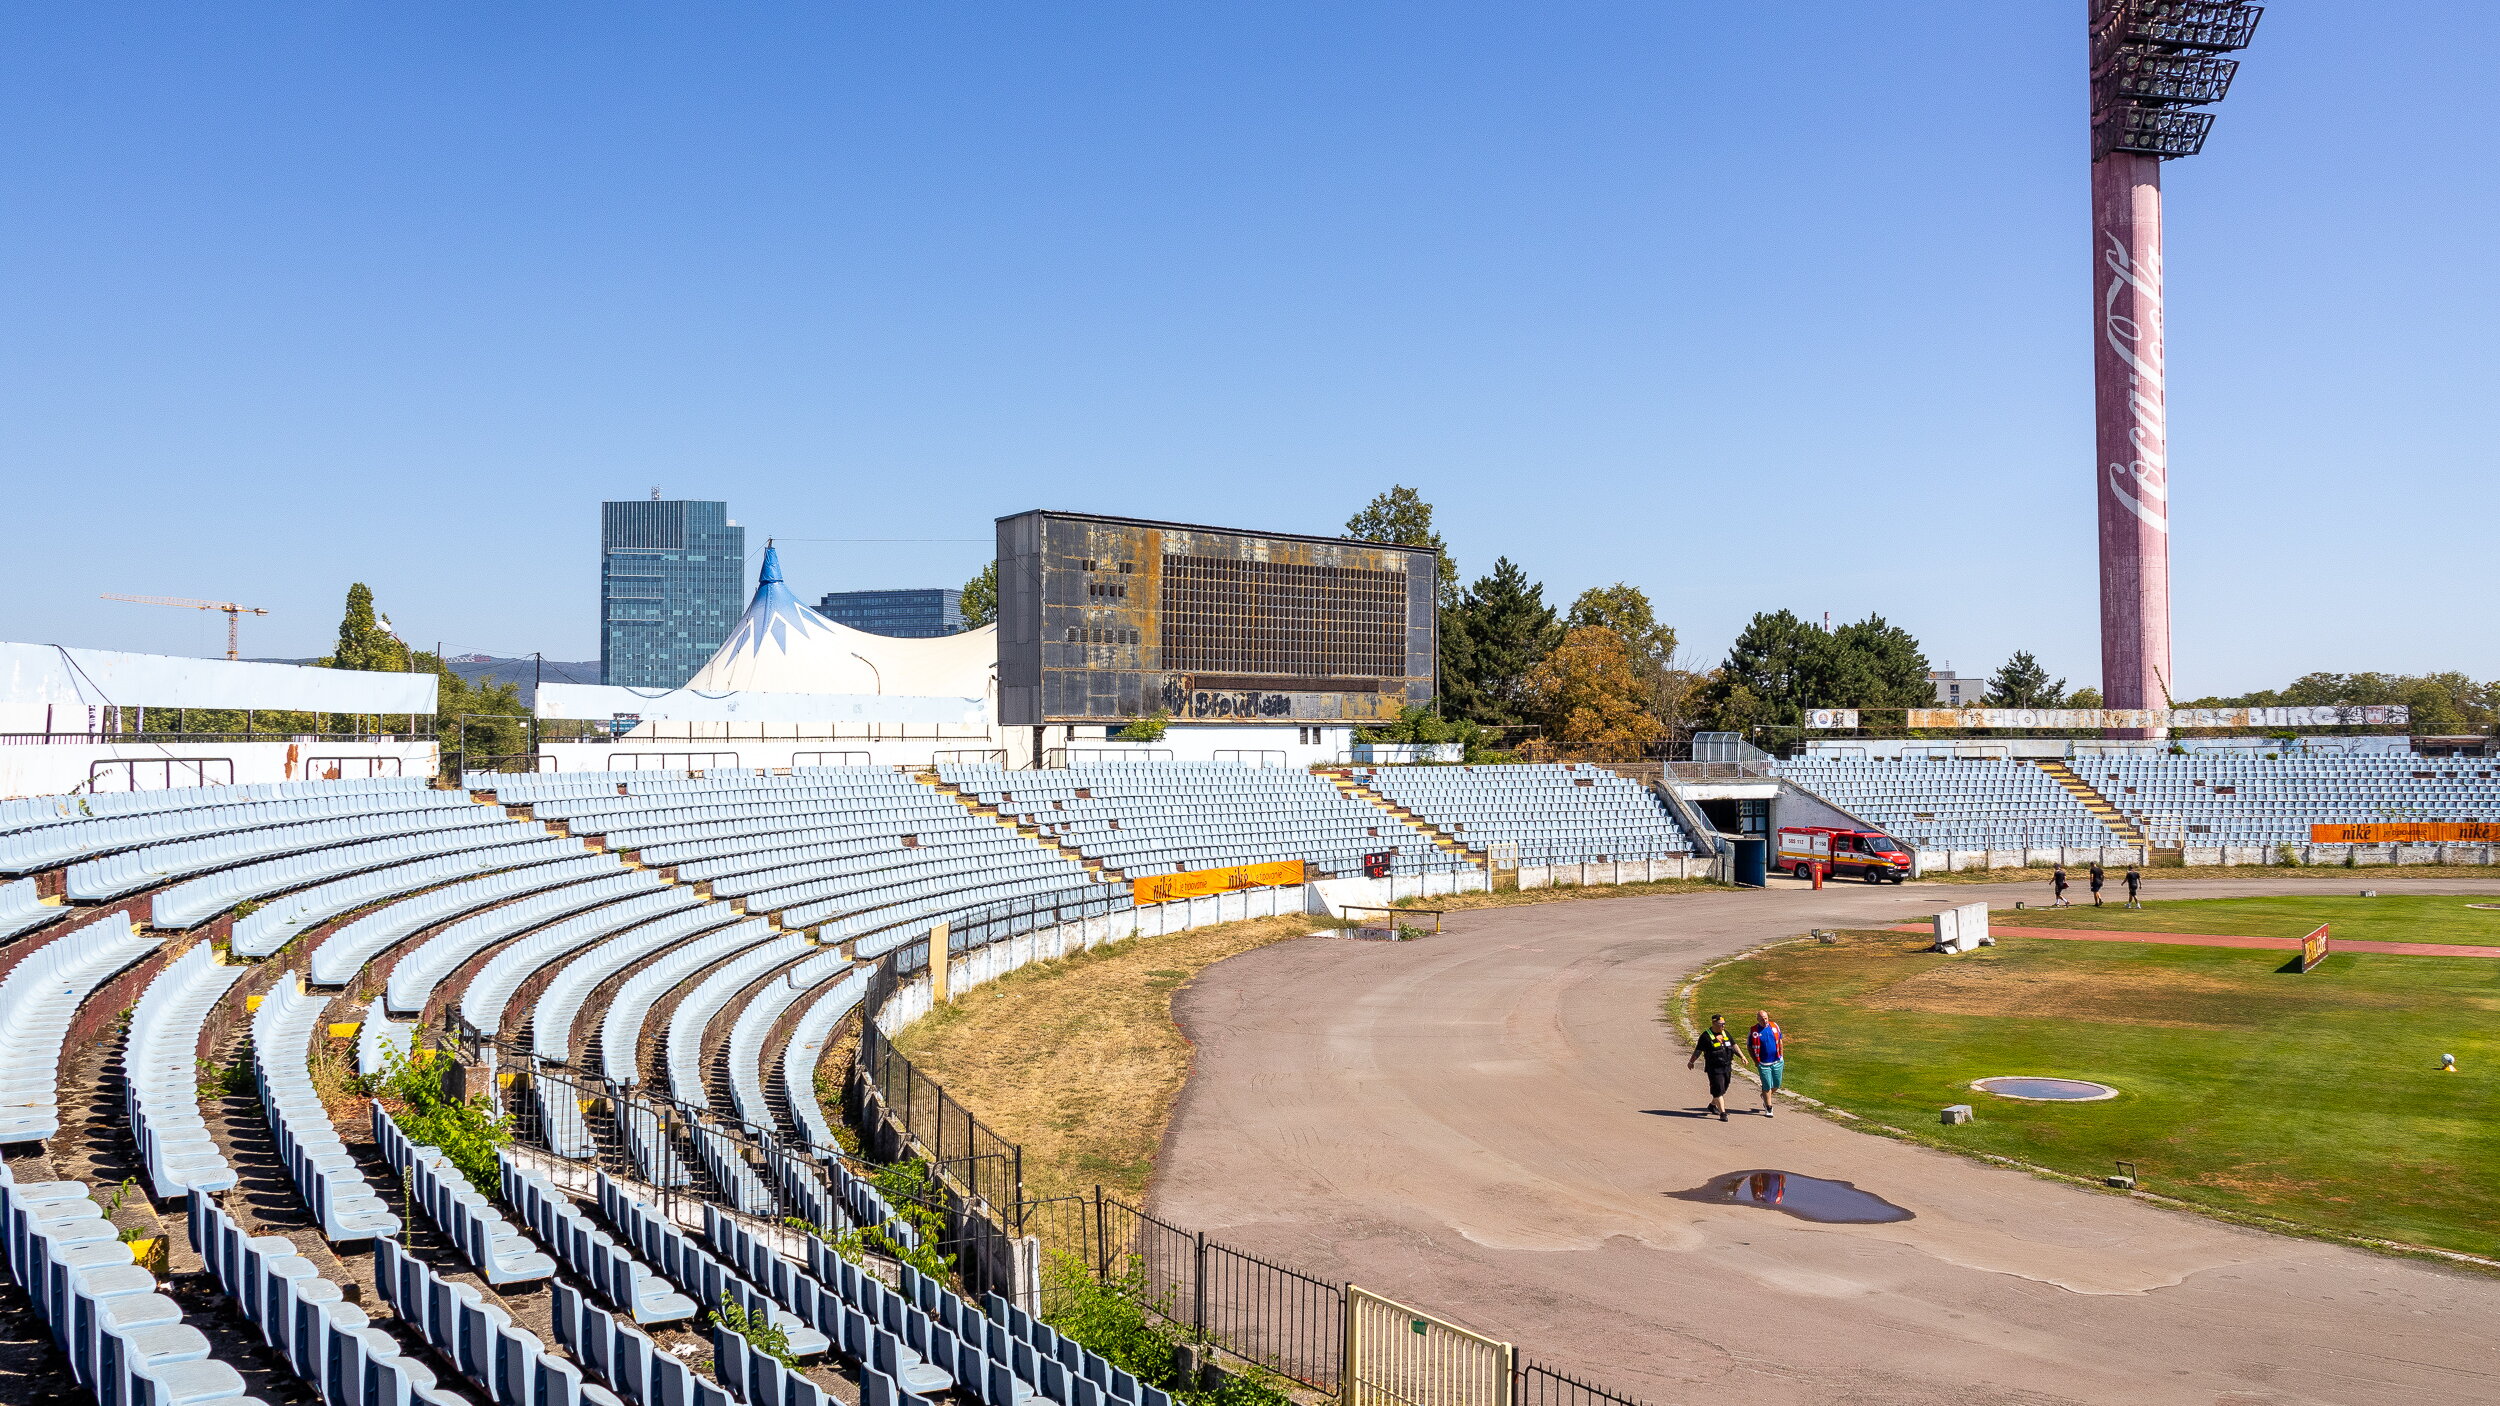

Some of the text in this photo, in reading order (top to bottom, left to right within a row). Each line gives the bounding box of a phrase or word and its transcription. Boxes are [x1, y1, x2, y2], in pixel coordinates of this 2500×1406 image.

[2342, 824, 2371, 840] niké
[2459, 823, 2490, 839] niké
[1228, 867, 1249, 889] niké
[1153, 876, 1172, 900] niké
